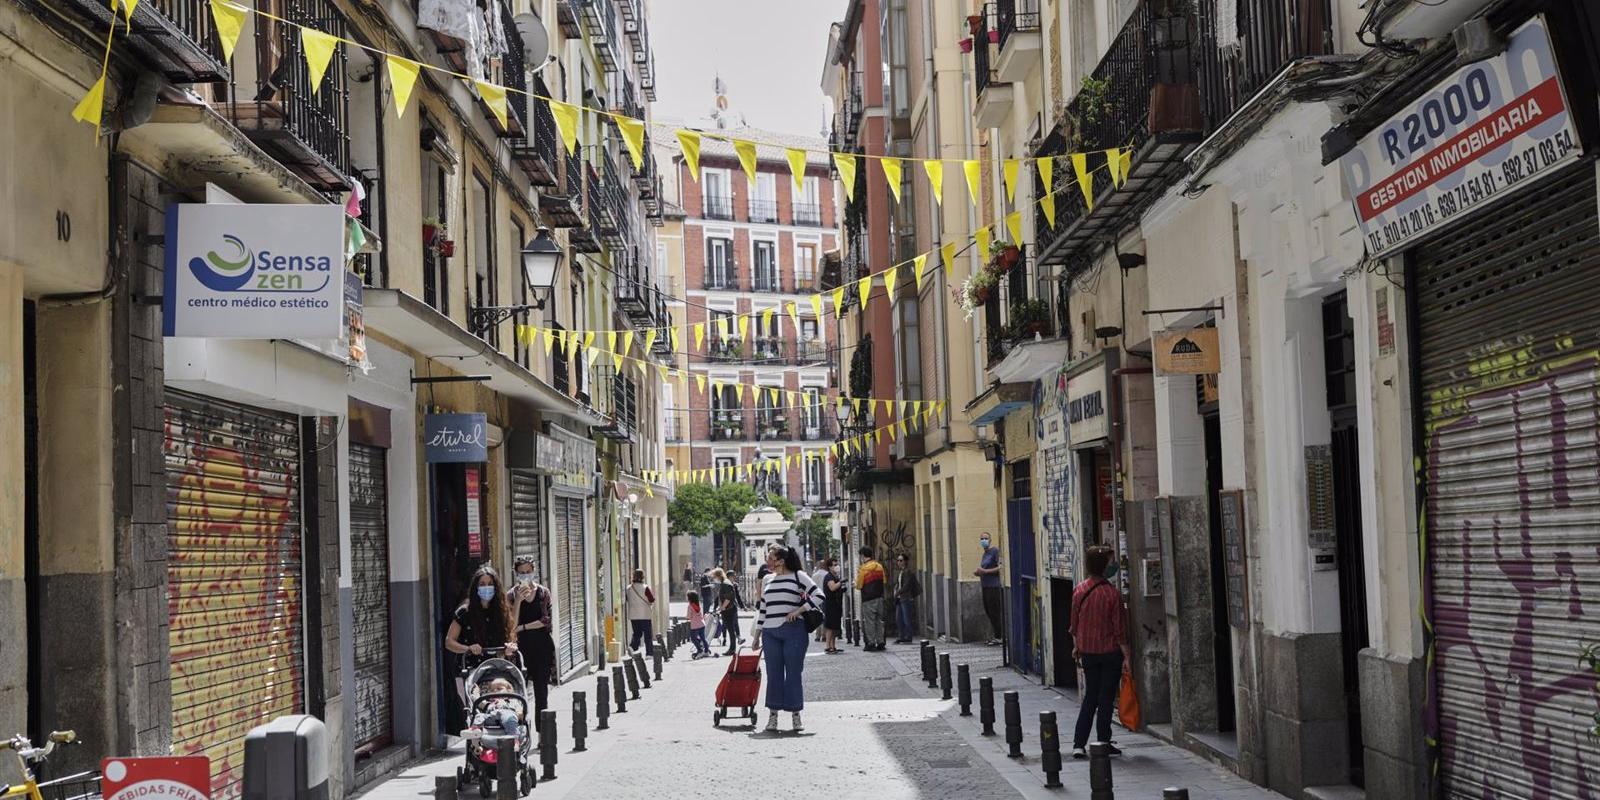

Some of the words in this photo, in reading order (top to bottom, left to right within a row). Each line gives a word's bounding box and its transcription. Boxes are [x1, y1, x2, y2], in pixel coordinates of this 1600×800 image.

[1369, 163, 1429, 210] GESTION
[1429, 97, 1543, 176] INMOBILIARIA
[1383, 221, 1400, 244] 910
[1399, 215, 1411, 237] 41
[1409, 209, 1423, 232] 20
[1421, 203, 1434, 226] 16
[1437, 191, 1457, 218] 639
[1454, 184, 1470, 210] 74
[1467, 176, 1484, 202] 54
[1481, 168, 1497, 196] 81
[1502, 155, 1525, 185] 692
[1523, 146, 1539, 175] 37
[1538, 138, 1557, 166] 03
[1555, 128, 1573, 158] 54
[56, 208, 71, 242] 10
[257, 250, 331, 271] Sensa
[256, 273, 303, 290] zen
[187, 297, 228, 308] centro
[231, 296, 277, 308] médico
[280, 297, 329, 309] estético
[426, 423, 487, 449] eturel
[117, 784, 165, 800] EBIDAS
[168, 786, 204, 800] FRÍA
